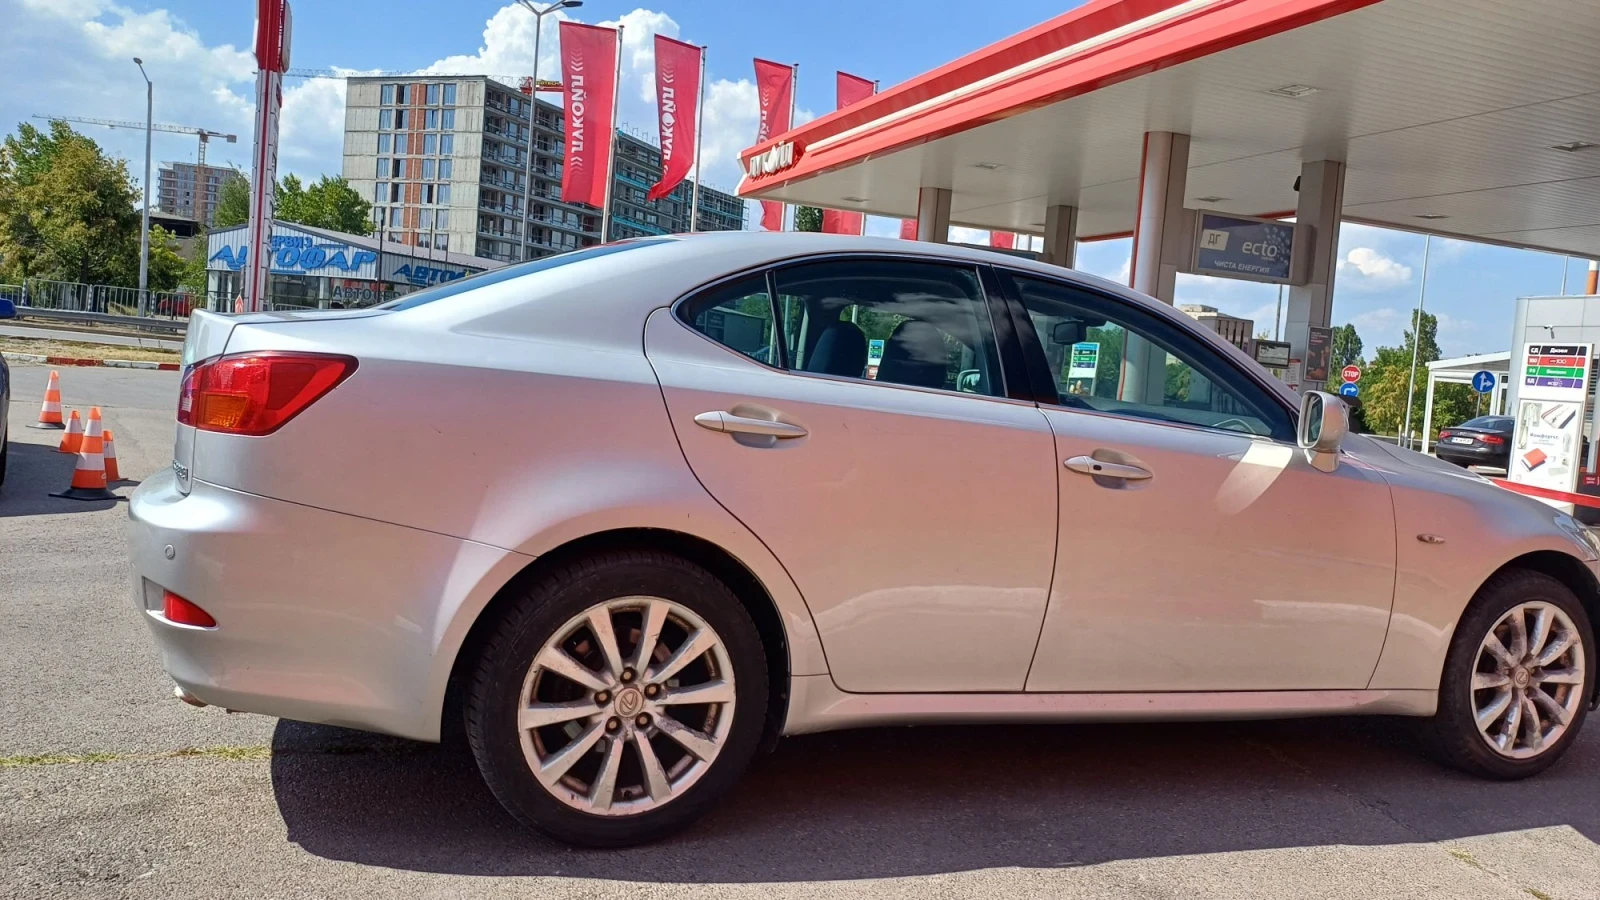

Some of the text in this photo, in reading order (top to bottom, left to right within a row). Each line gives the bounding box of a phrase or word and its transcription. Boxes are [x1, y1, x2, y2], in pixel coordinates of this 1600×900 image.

[1208, 233, 1221, 246] ДГ
[1242, 241, 1278, 257] ecto
[1214, 260, 1270, 274] ЧИСТА ЕНЕРГИЯ
[1343, 370, 1359, 378] STOP
